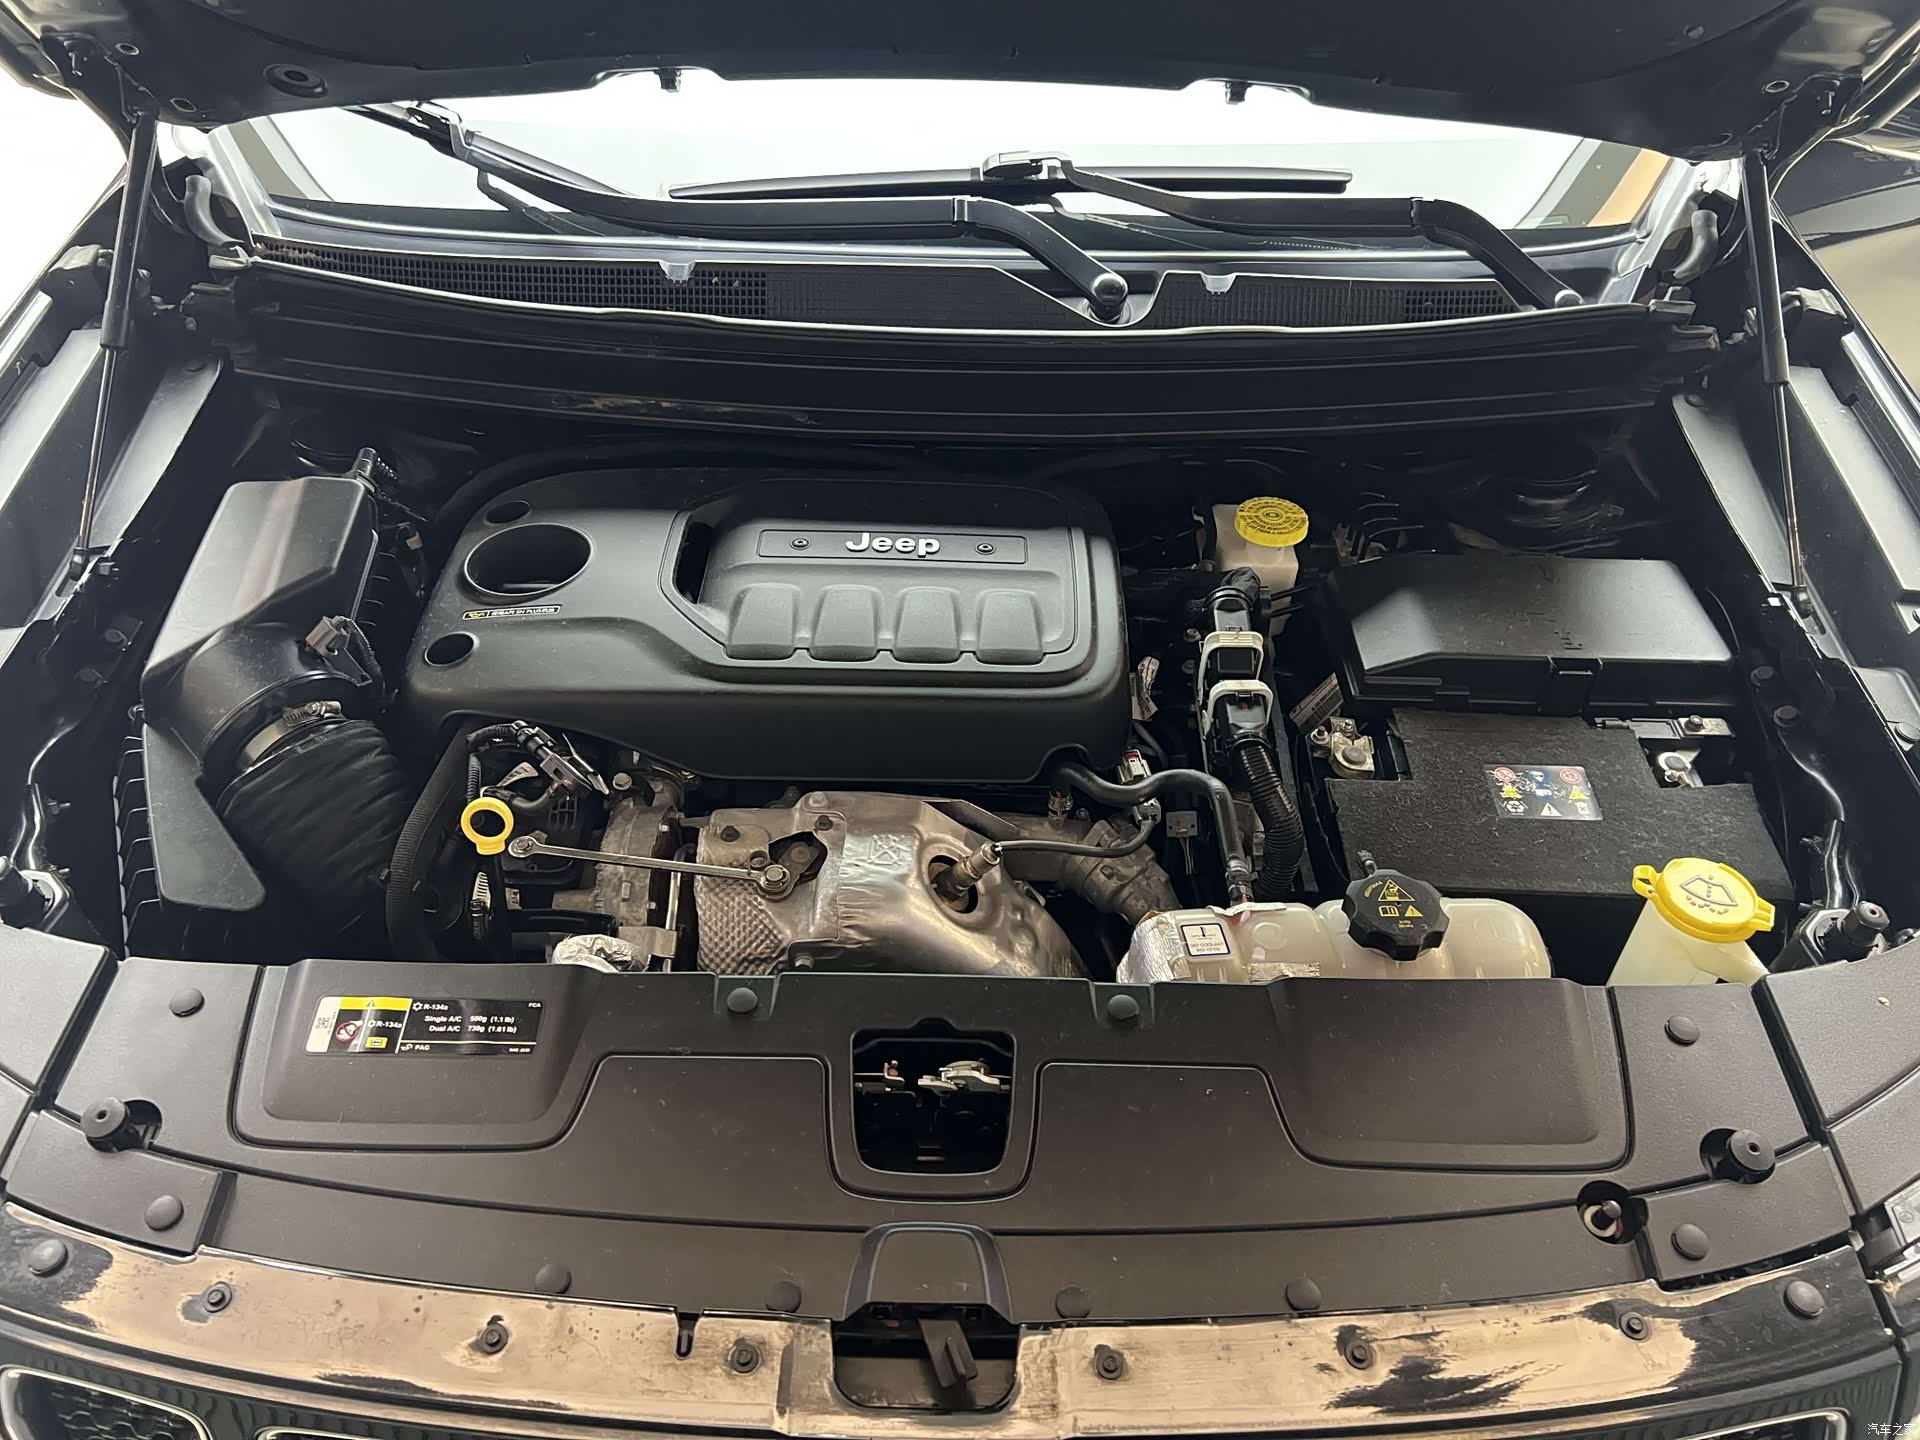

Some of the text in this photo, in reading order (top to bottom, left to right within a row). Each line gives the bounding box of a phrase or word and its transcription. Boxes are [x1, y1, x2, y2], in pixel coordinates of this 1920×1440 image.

[846, 533, 940, 557] Jeep
[423, 1003, 449, 1011] R-134a
[424, 1015, 448, 1023] Single
[469, 1015, 488, 1023] 500g
[376, 1020, 403, 1029] R-134a
